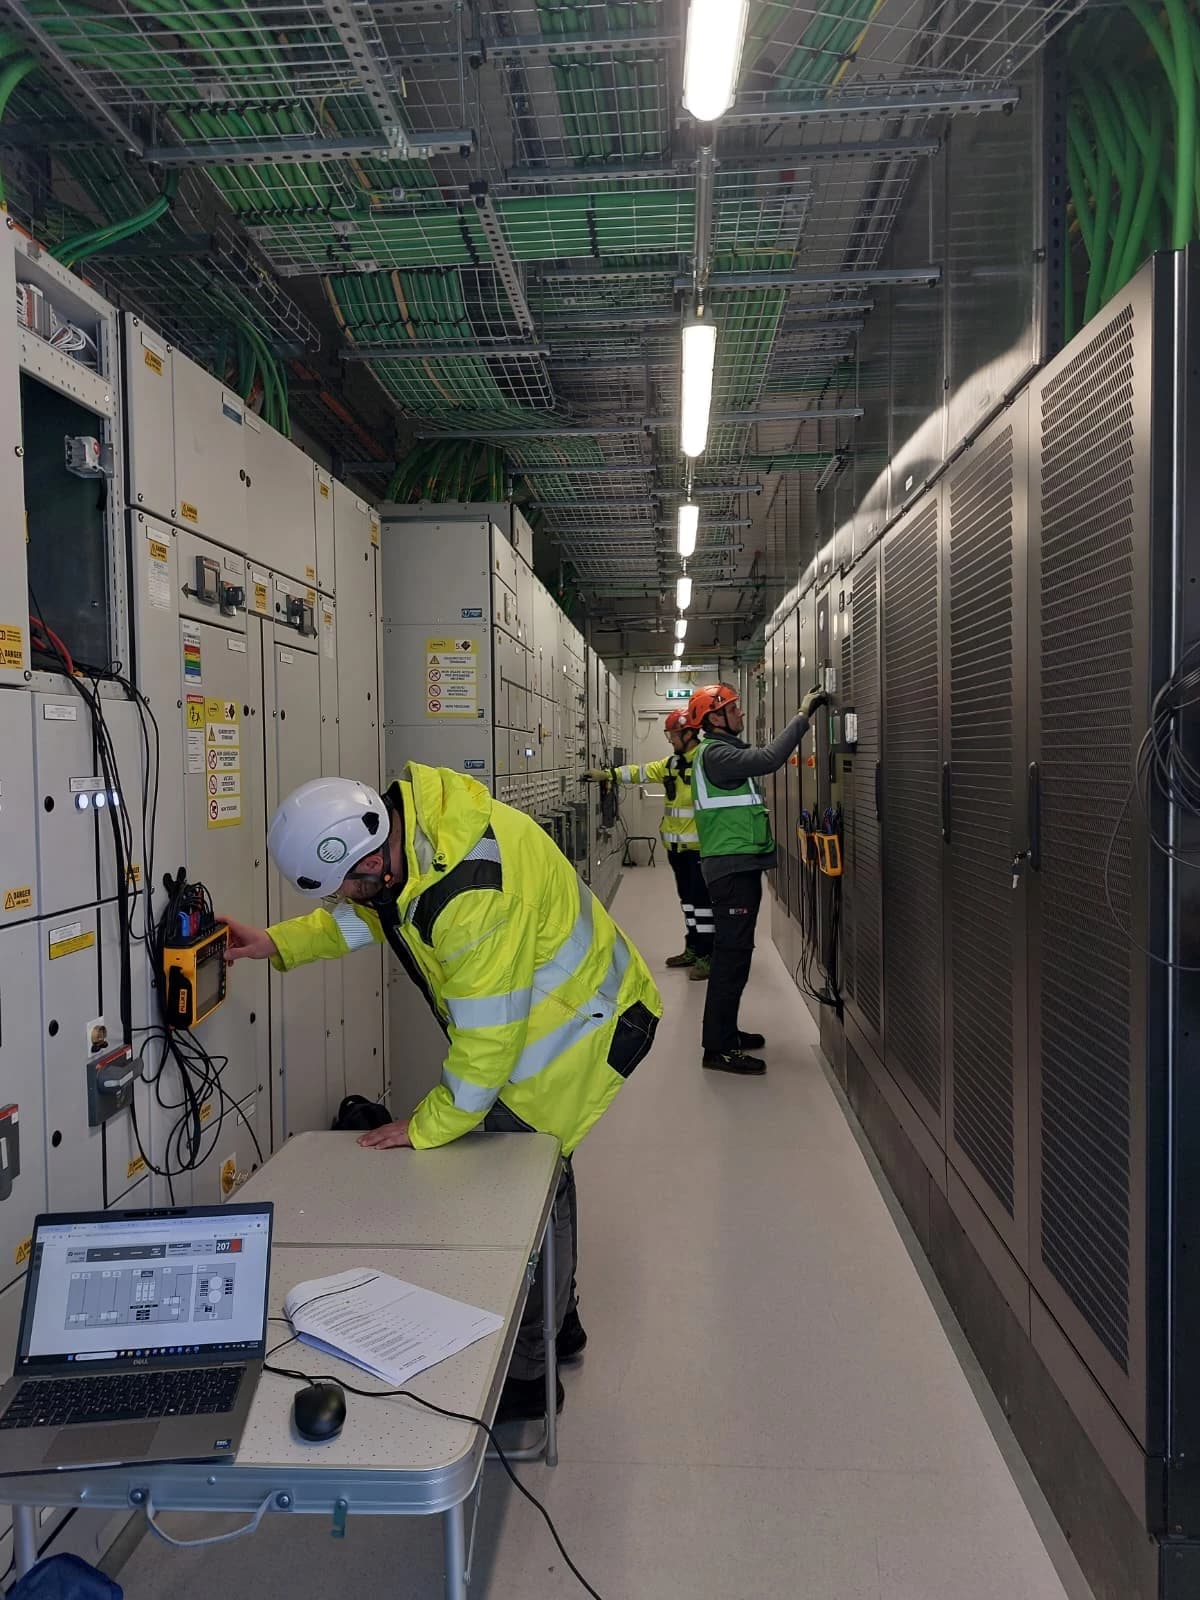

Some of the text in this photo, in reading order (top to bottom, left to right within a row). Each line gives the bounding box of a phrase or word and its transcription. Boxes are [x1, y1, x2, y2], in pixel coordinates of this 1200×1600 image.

[5, 650, 22, 659] DANGER
[14, 889, 30, 899] DANGER
[217, 1242, 230, 1251] 207
